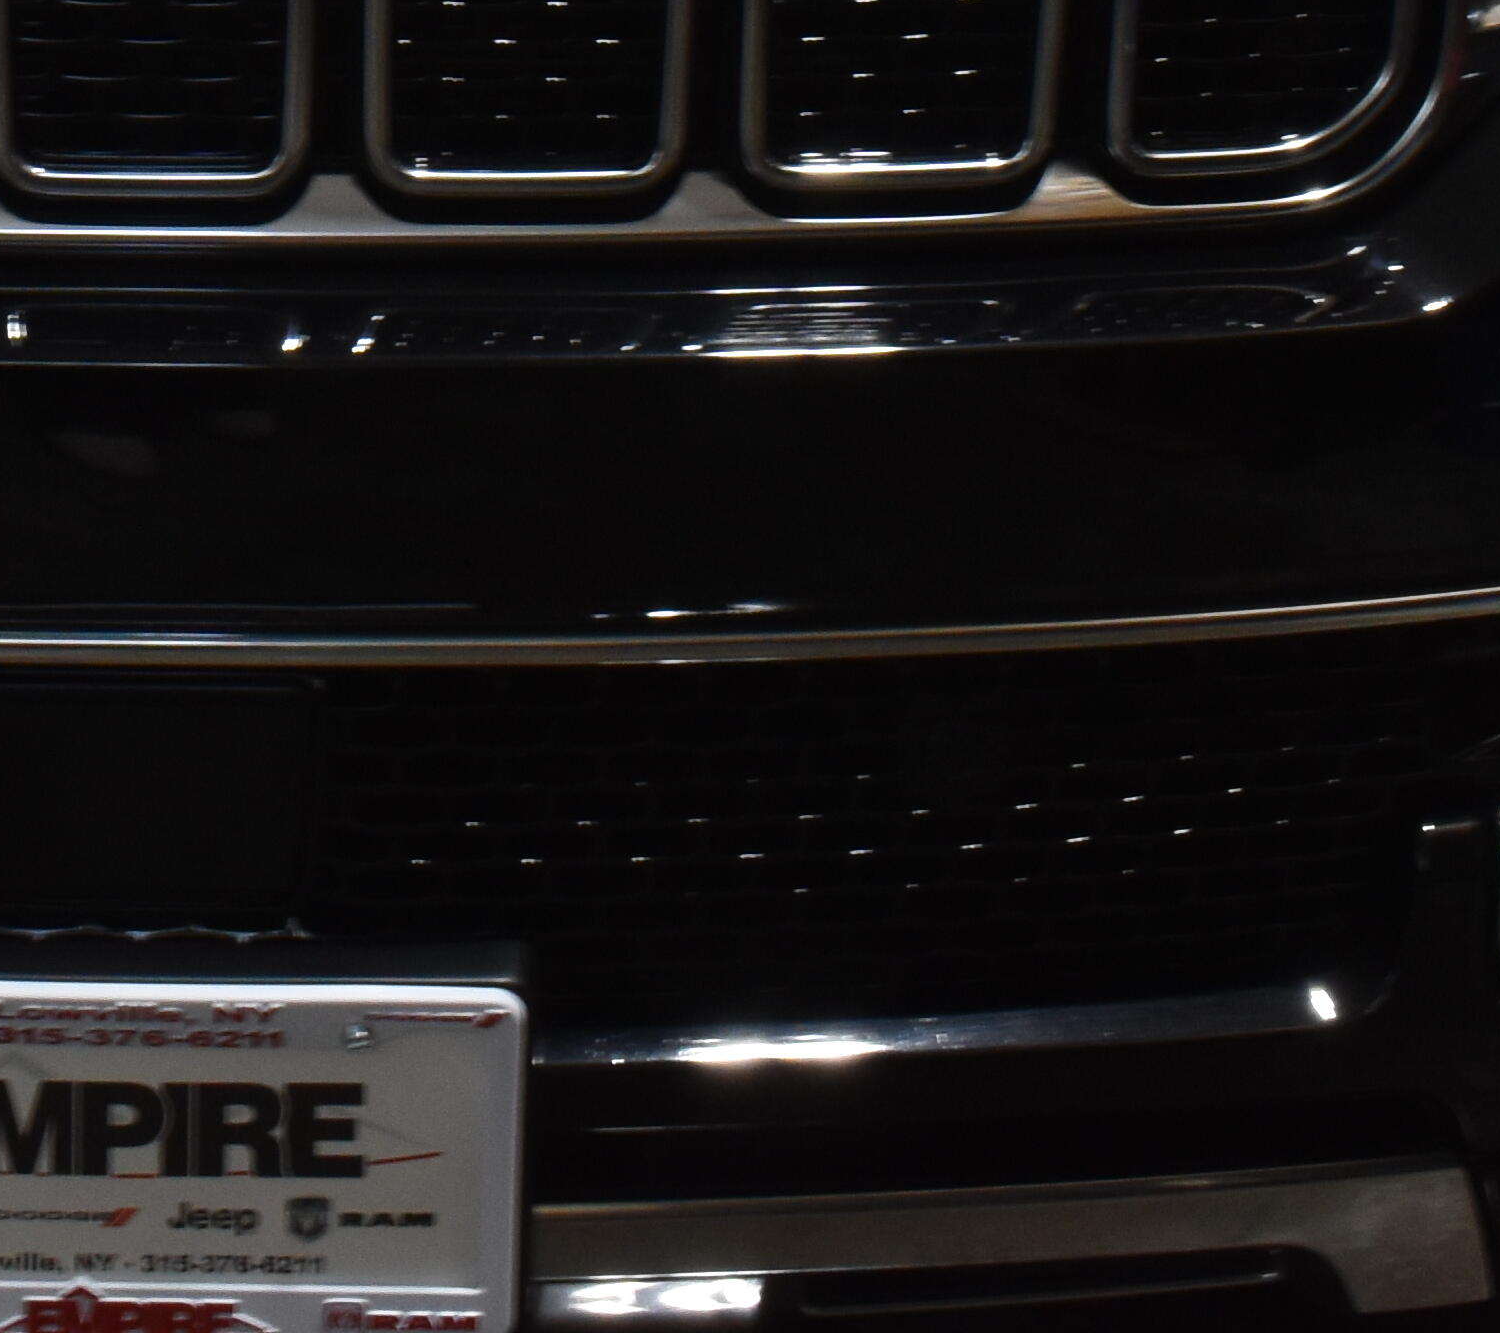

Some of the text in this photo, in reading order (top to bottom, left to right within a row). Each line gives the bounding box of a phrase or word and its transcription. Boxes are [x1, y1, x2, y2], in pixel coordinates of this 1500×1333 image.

[211, 1000, 286, 1023] NY
[167, 1201, 260, 1235] Jeep
[338, 1211, 434, 1227] RAM
[75, 1253, 118, 1271] NY
[366, 1310, 485, 1330] RAM
